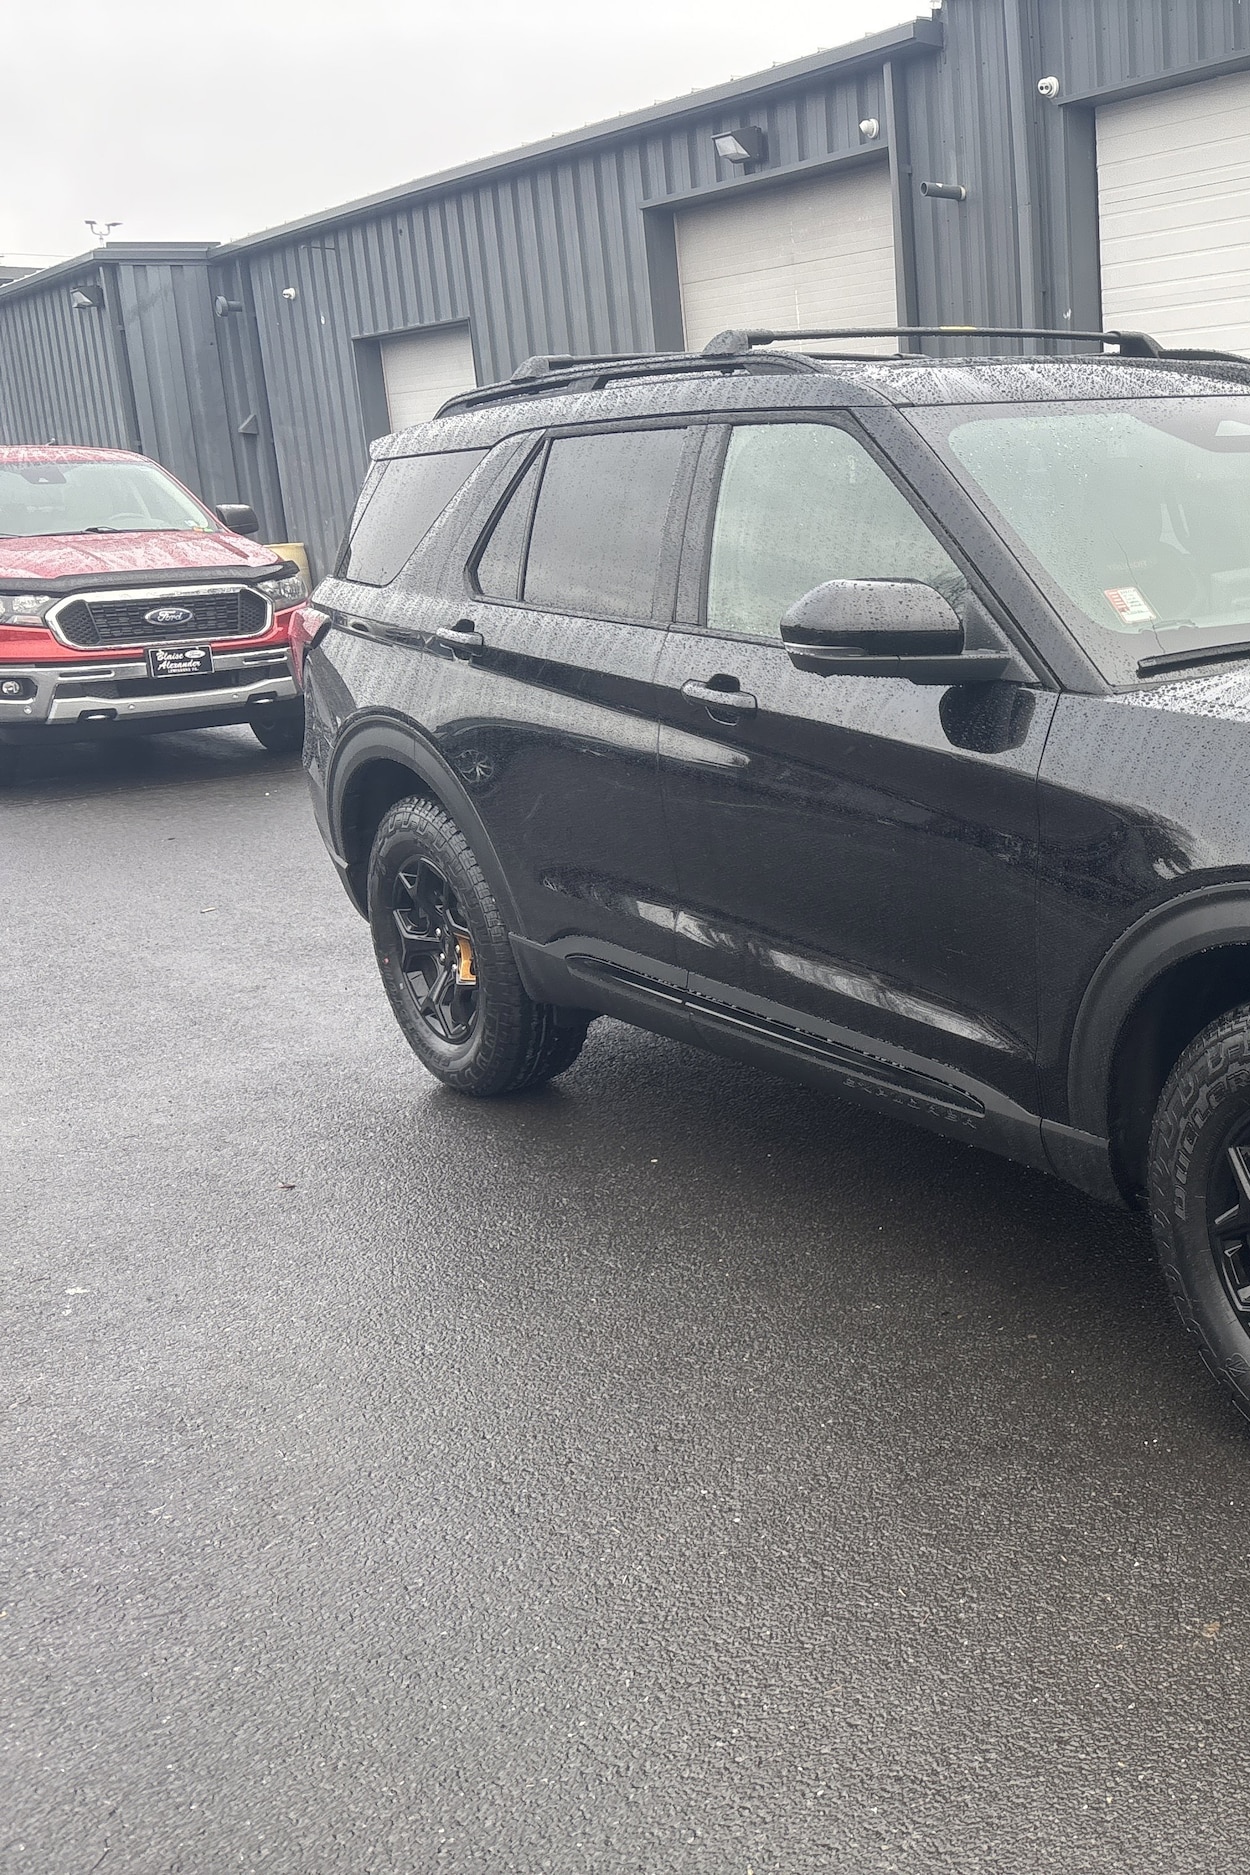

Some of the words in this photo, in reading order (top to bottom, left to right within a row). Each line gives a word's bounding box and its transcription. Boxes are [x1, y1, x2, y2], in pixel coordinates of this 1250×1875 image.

[157, 610, 182, 621] Ford
[156, 650, 184, 661] Blaise
[157, 659, 202, 671] Alexander
